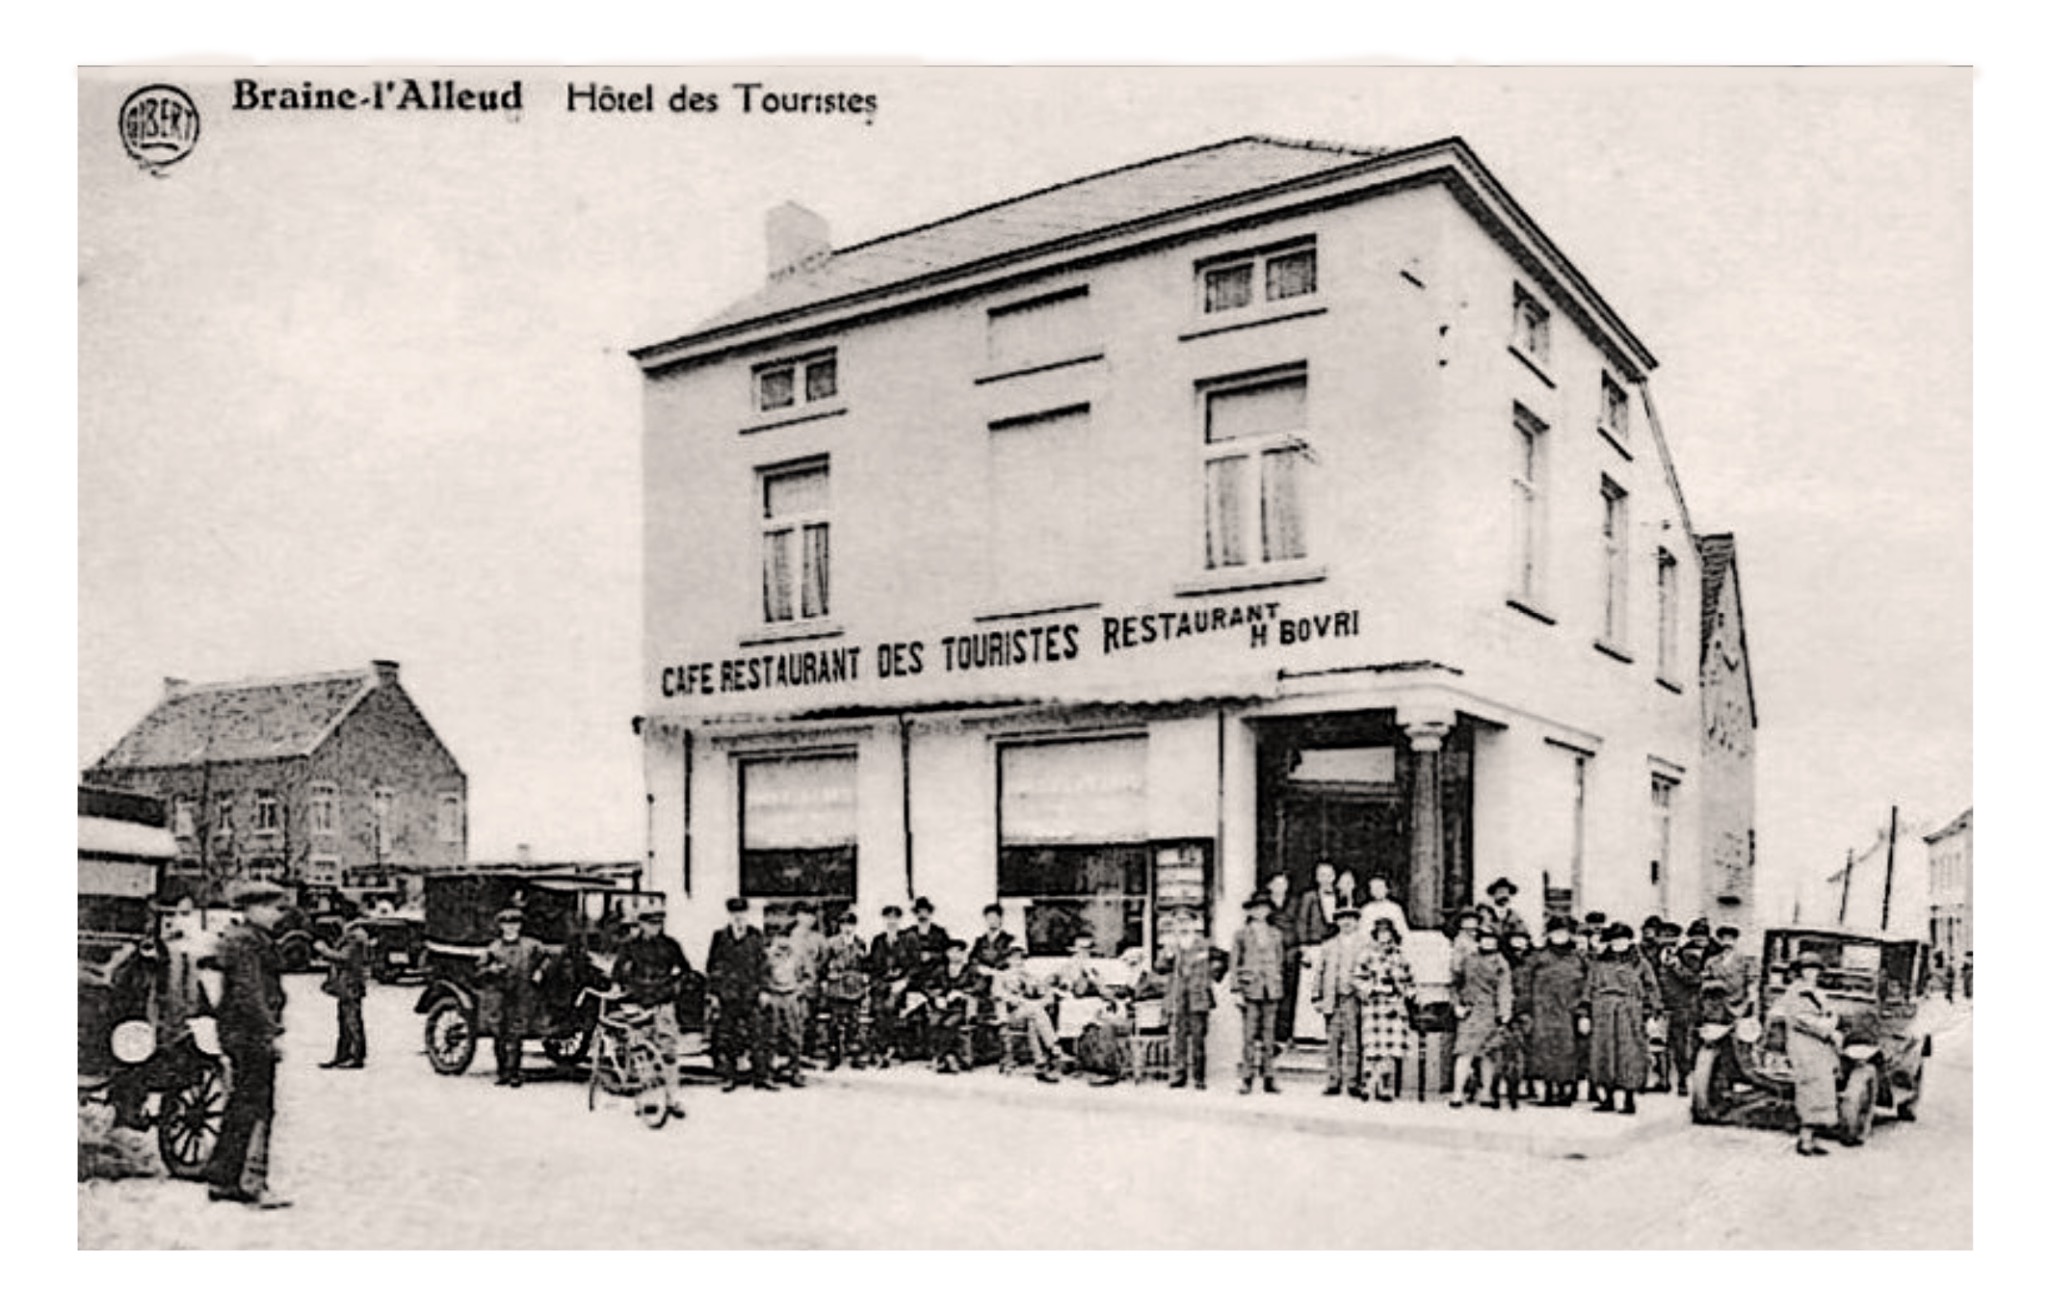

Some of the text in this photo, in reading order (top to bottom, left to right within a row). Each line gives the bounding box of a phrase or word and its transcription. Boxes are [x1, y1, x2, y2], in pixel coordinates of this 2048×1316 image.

[1102, 602, 1281, 655] RESTAURANT
[1250, 610, 1361, 649] H BOVRI
[661, 624, 1080, 698] CAFE RESTAURANT DES TOURISTES
